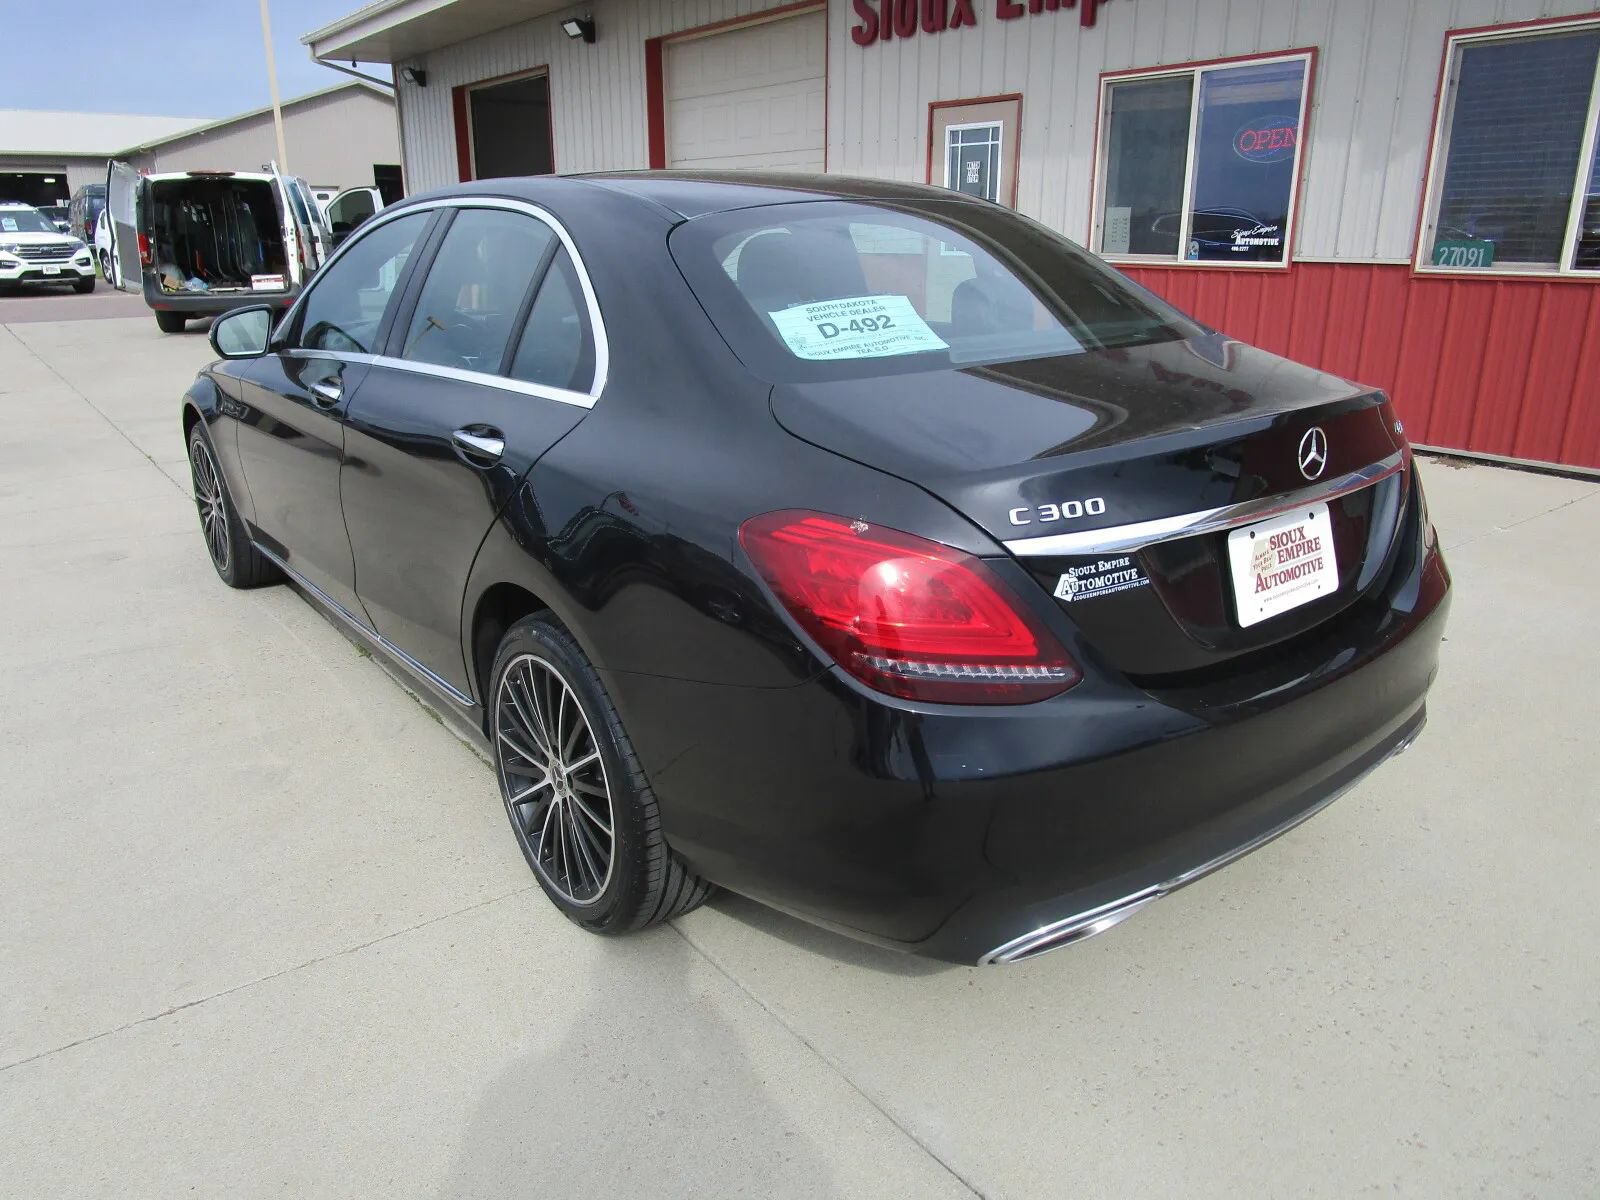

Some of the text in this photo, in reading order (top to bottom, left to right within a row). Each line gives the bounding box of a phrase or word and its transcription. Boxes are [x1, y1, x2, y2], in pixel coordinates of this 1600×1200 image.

[852, 0, 977, 46] Sioux
[1239, 127, 1298, 152] OPEN
[1252, 224, 1278, 236] Empire
[1439, 247, 1484, 267] 27091
[806, 299, 878, 314] SOUTH DAKOTA
[806, 305, 887, 322] VEHICLE DEALER
[816, 314, 897, 339] D-492
[1008, 497, 1106, 526] C 300
[1268, 526, 1307, 551] SIOUX
[1276, 536, 1322, 564] EMPIRE
[1068, 556, 1130, 578] SIOUX EMPIRE
[1254, 557, 1324, 594] AUTOMOTIVE
[1061, 568, 1138, 595] AUTOMOTIVE
